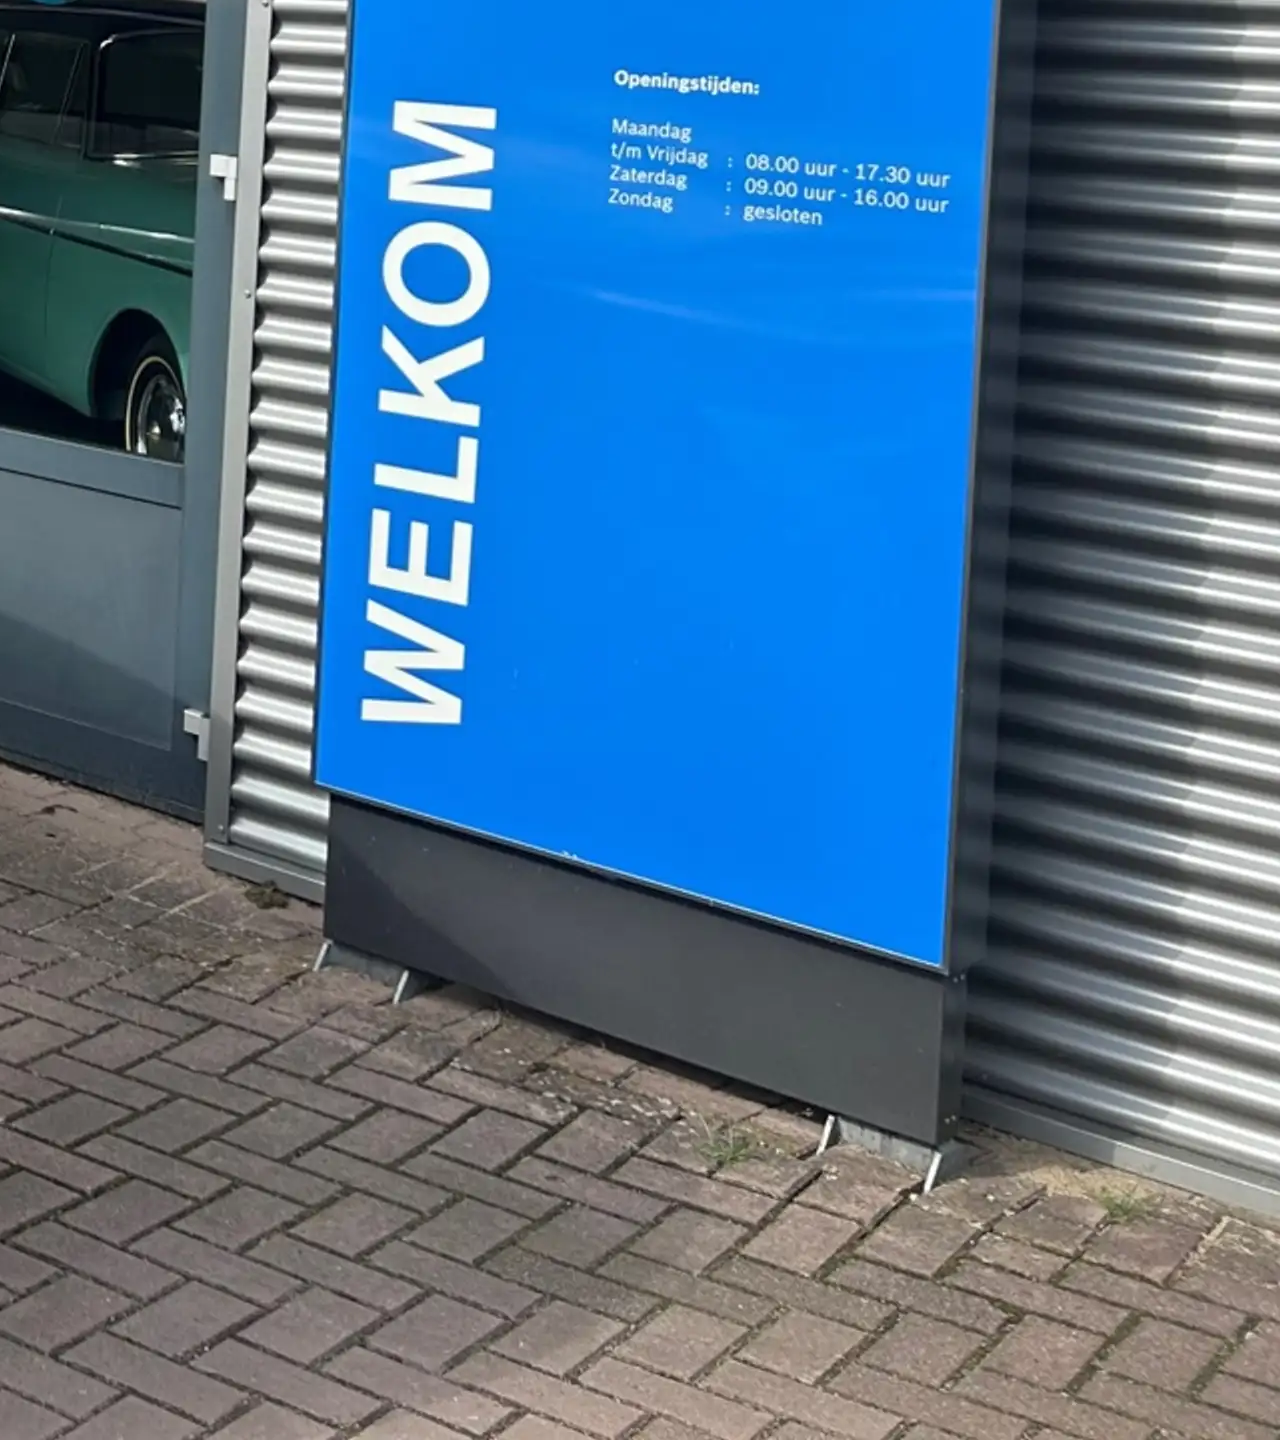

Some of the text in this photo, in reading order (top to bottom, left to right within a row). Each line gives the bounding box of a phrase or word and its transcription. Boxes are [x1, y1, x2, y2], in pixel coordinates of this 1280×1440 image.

[614, 69, 760, 96] Openingstijden:
[611, 118, 692, 143] Maandag
[610, 142, 641, 160] t/m
[646, 144, 708, 169] Vrijdag
[745, 153, 799, 173] 08.00
[804, 162, 837, 176] uur
[855, 163, 911, 185] 17.30
[915, 172, 951, 188] uur
[607, 188, 674, 213] Zondag
[742, 204, 823, 226] gesloten
[609, 164, 688, 191] Zaterdag
[743, 177, 798, 198] 09.00
[803, 186, 836, 201] uur
[853, 188, 909, 210] 16.00
[915, 197, 950, 213] uur
[360, 100, 497, 725] WELKOM
